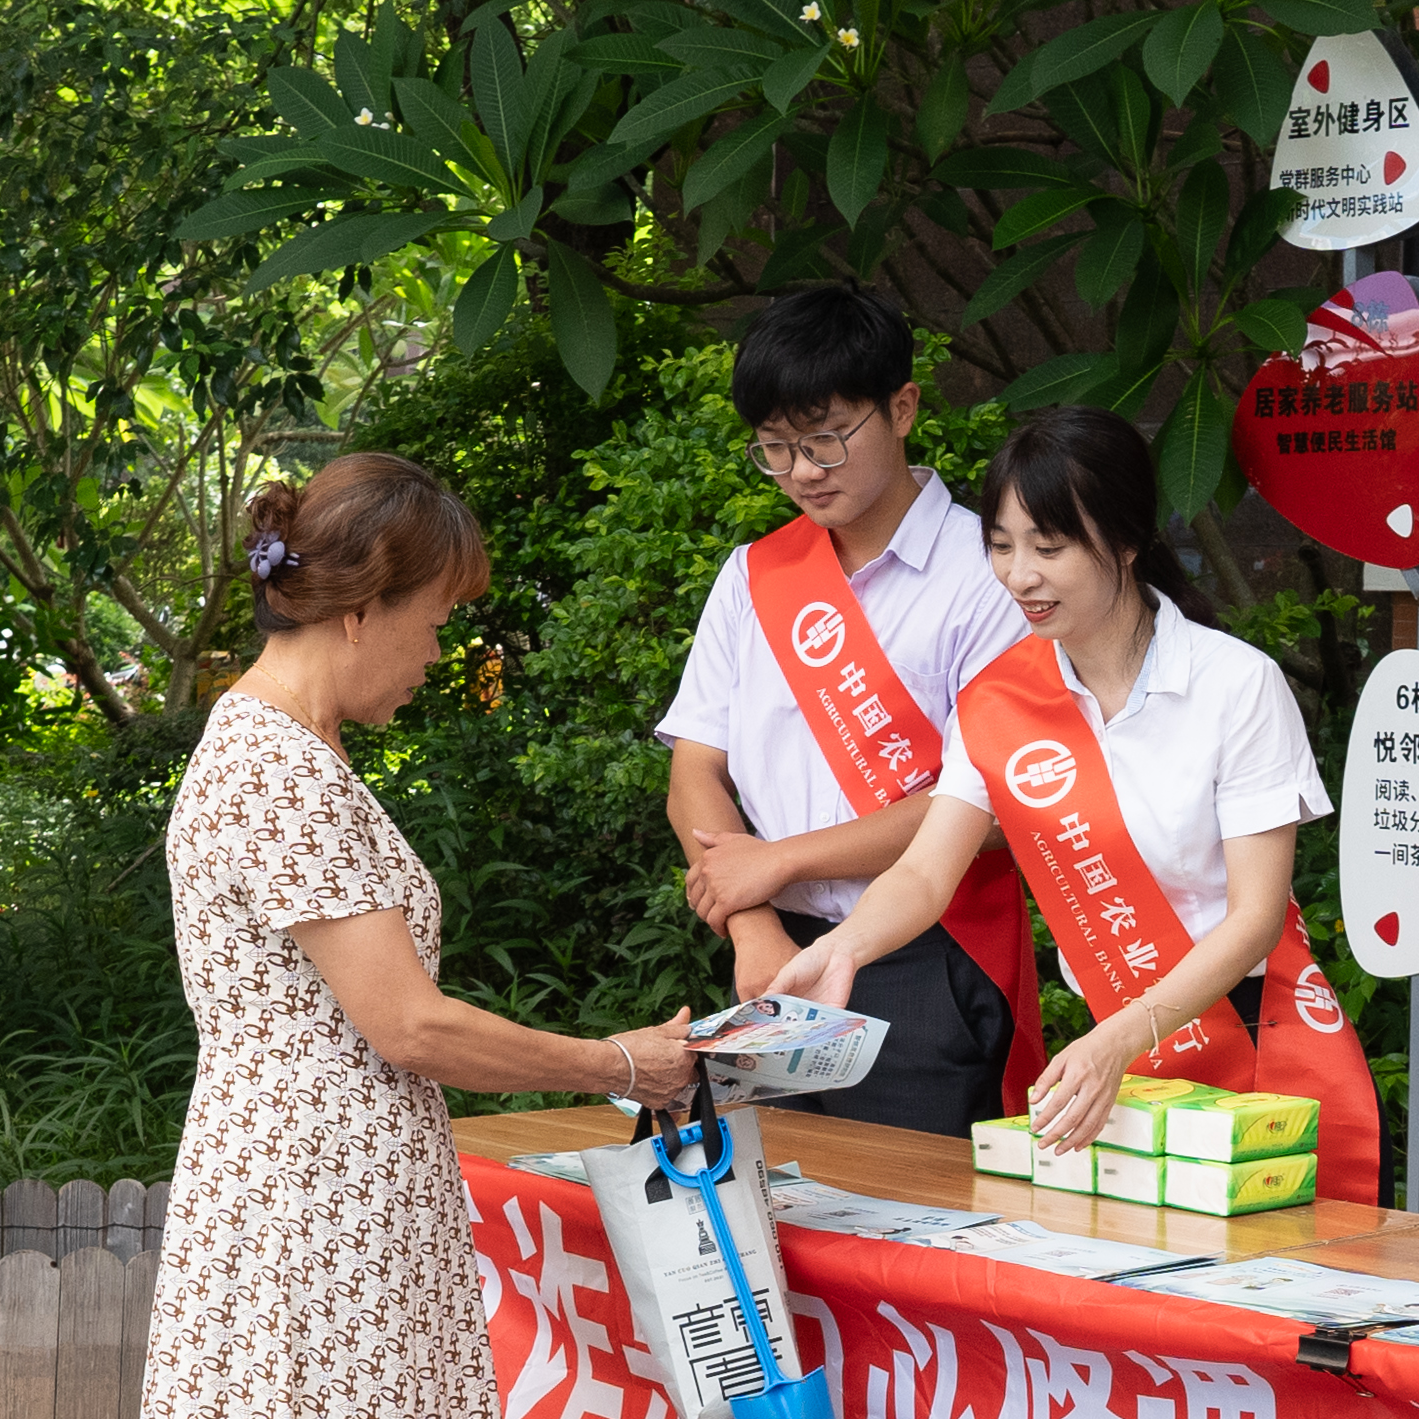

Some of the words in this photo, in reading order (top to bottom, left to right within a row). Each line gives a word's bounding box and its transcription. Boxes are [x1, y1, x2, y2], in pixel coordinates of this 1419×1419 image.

[1286, 96, 1410, 140] 室外健身区
[1279, 162, 1372, 191] 党群服务中心
[1350, 299, 1390, 334] 8栋
[1254, 379, 1419, 417] 居家养老服务站
[1276, 428, 1397, 455] 智慧便民生活馆
[816, 687, 877, 789] AGRICULTURAL
[1029, 830, 1098, 948] AGRICULTURAL
[1094, 948, 1127, 998] BANK
[1056, 810, 1210, 1054] 中国农业行
